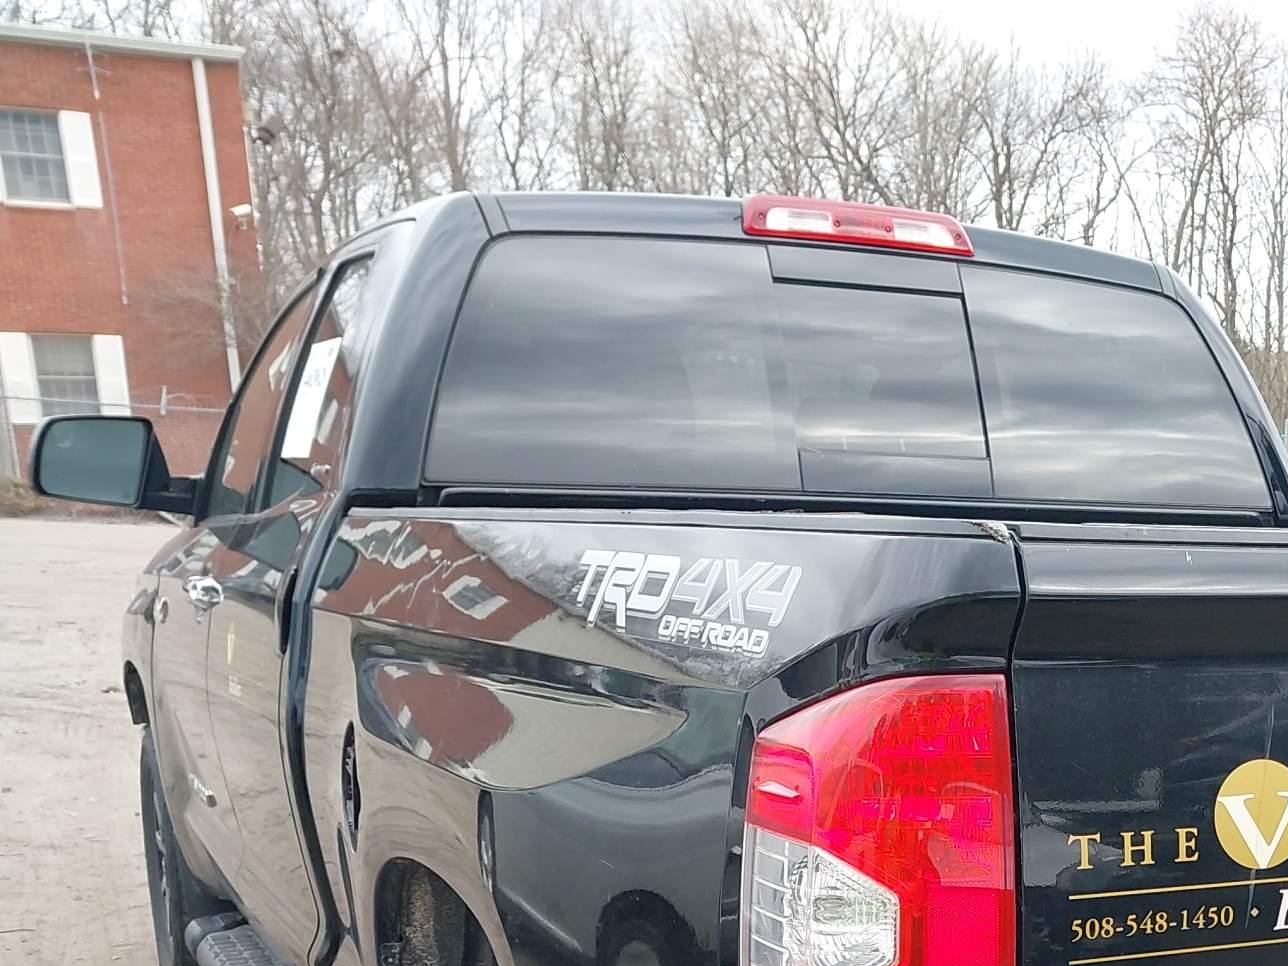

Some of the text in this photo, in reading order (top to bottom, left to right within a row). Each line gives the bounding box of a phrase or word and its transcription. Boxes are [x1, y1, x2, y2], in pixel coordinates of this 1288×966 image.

[575, 549, 681, 632] TRD
[1067, 826, 1200, 871] THE
[1070, 906, 1235, 943] 508-548-1450
